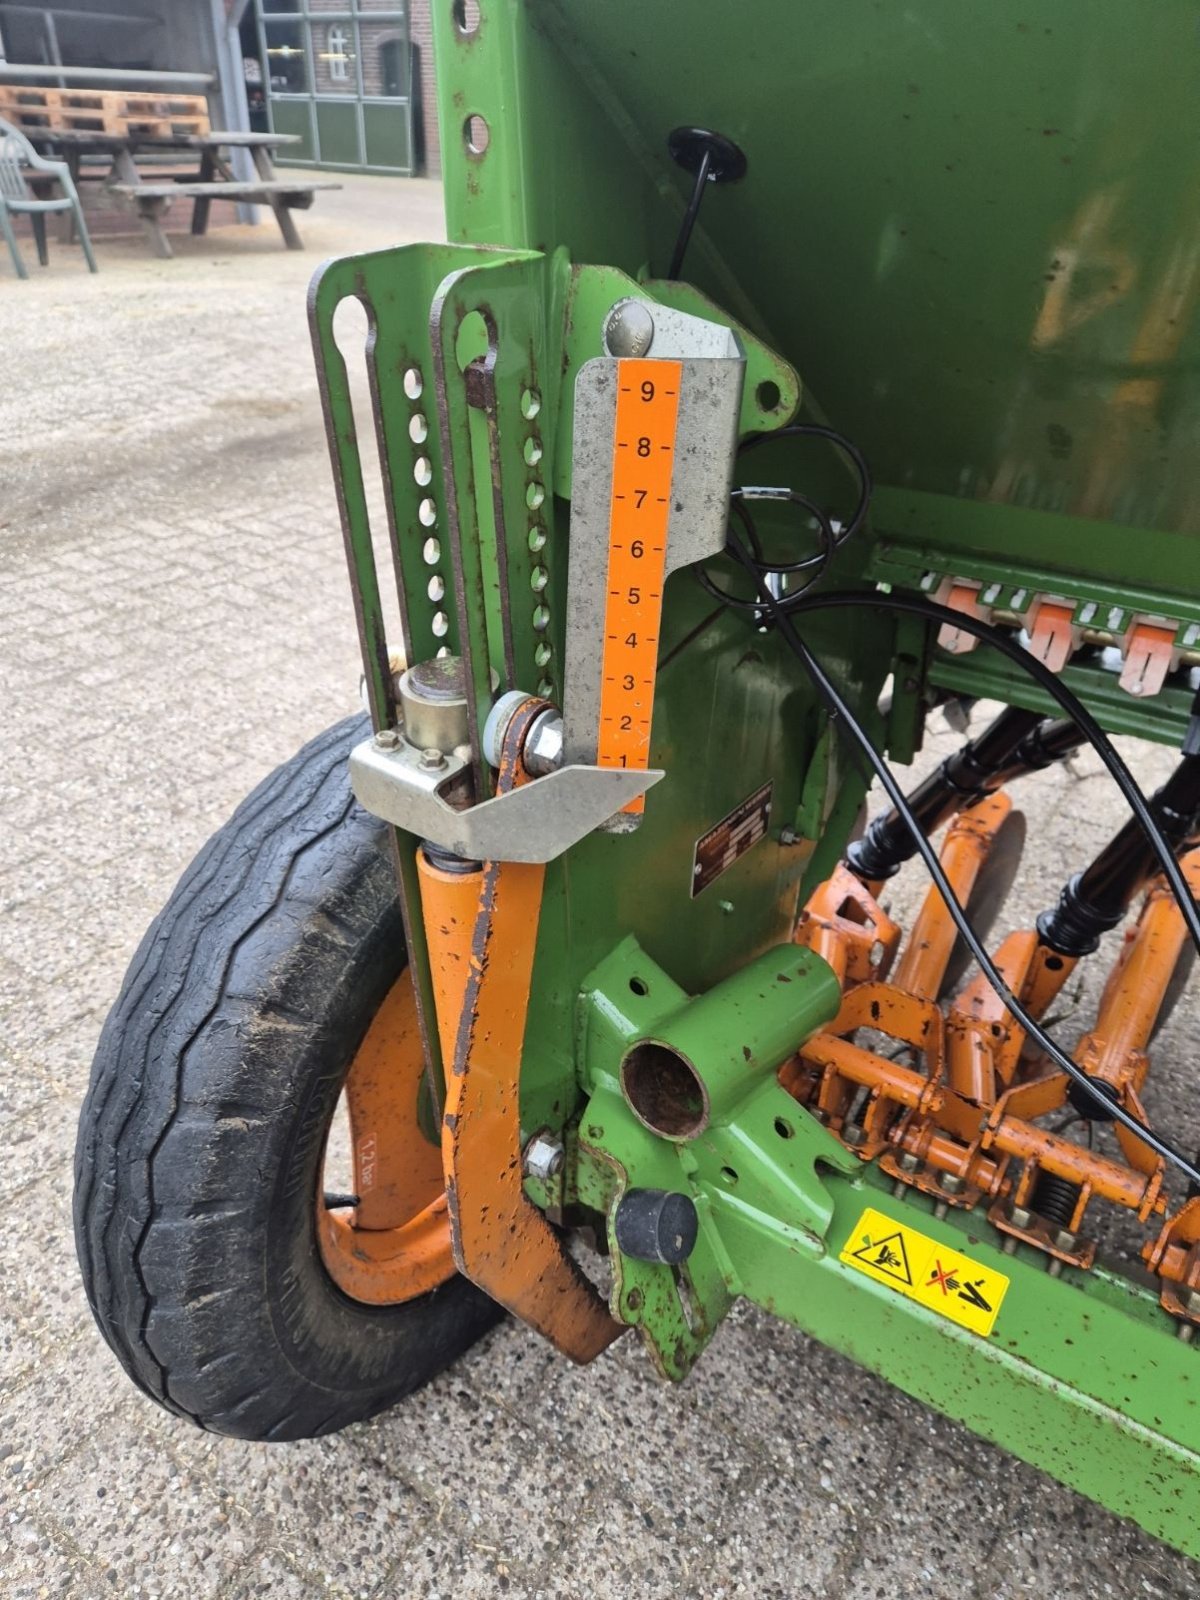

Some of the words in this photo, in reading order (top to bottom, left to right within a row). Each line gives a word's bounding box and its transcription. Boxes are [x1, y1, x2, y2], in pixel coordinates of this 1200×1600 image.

[640, 380, 655, 402] 9
[637, 437, 651, 458] 8
[634, 489, 648, 509] 7
[631, 540, 644, 559] 6
[628, 588, 641, 605] 5
[625, 632, 638, 649] 4
[622, 675, 635, 691] 3
[619, 715, 632, 731] 2
[618, 754, 627, 769] 1
